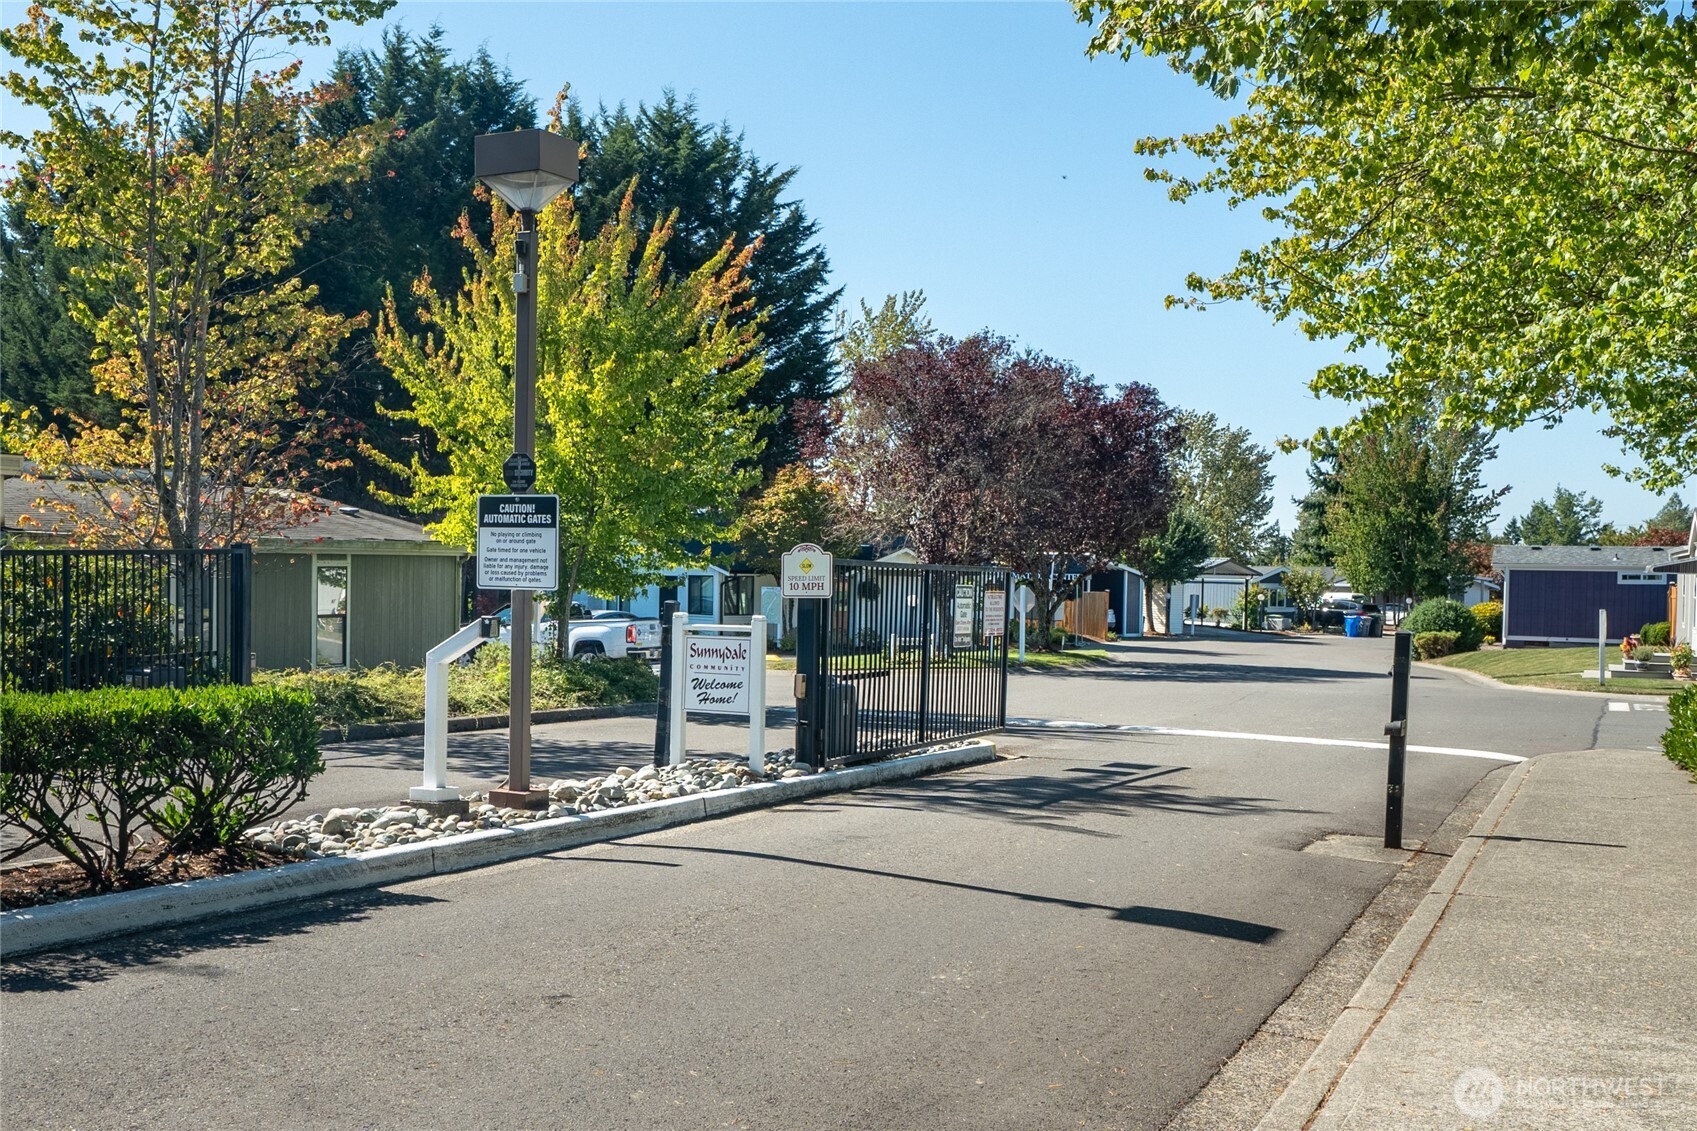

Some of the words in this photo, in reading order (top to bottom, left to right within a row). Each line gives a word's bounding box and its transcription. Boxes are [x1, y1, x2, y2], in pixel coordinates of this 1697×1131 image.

[499, 504, 536, 513] CAUTION!
[483, 514, 526, 524] AUTOMATIC
[527, 514, 552, 524] GATES
[690, 643, 747, 663] Sunnydale
[691, 678, 743, 690] Welcome
[696, 692, 738, 704] Home!
